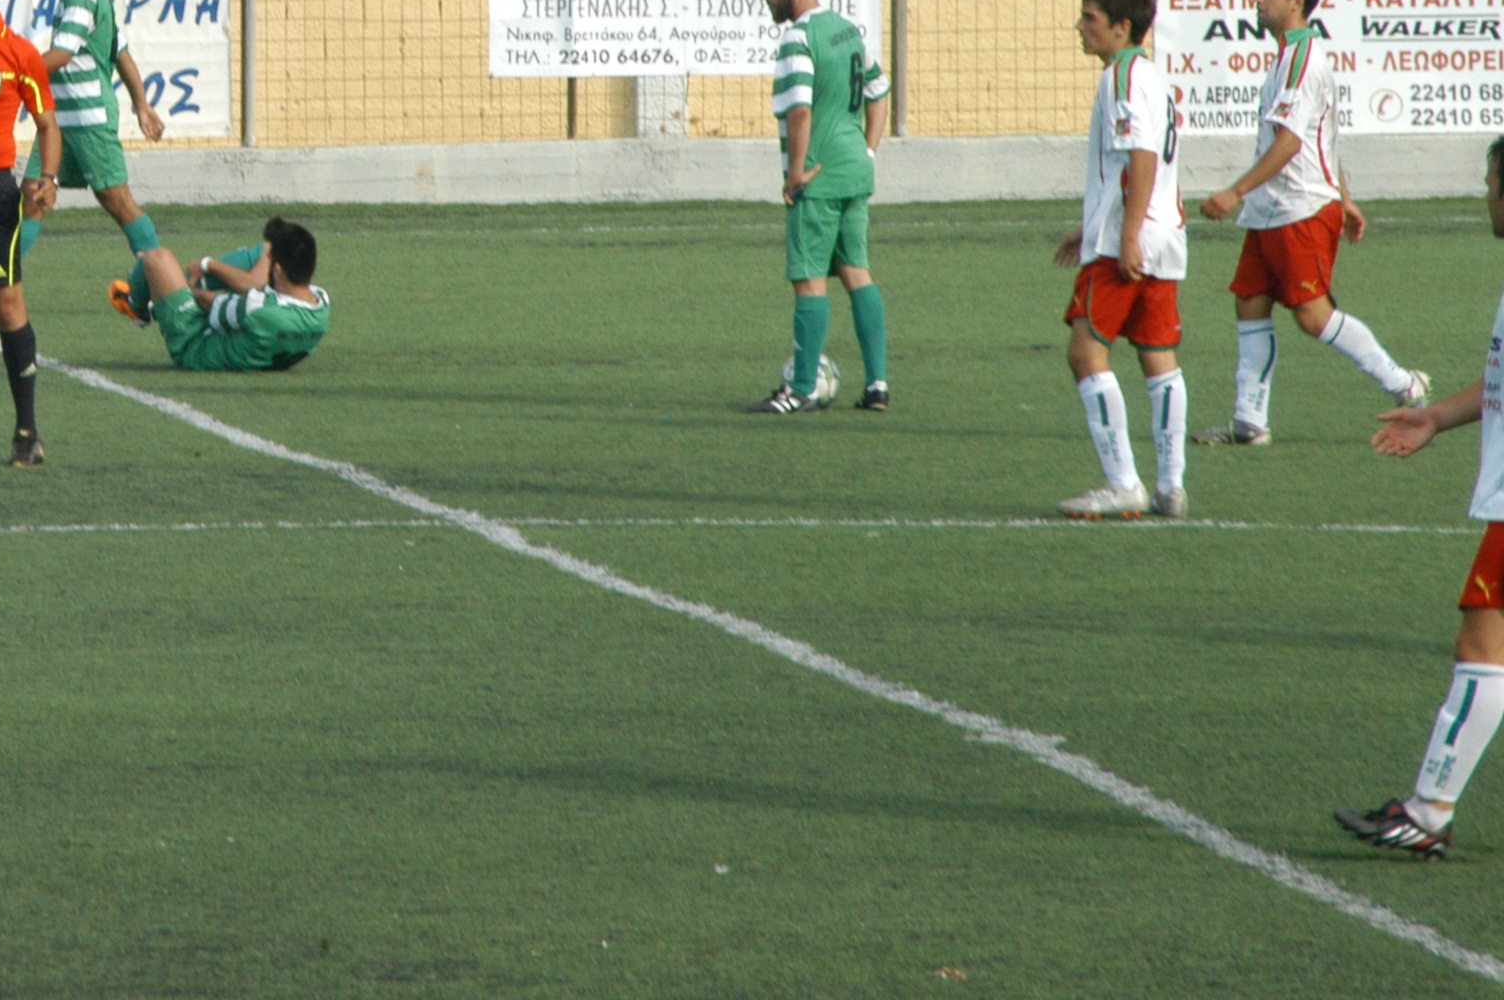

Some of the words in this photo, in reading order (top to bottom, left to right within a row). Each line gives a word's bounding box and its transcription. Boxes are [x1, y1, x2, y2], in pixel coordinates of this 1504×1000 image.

[1361, 14, 1502, 41] WALKER
[559, 49, 610, 66] 22410
[849, 52, 864, 114] 6
[1410, 84, 1472, 102] 22410
[1189, 109, 1259, 129] ΚΟΛΟΚΟΤΡ
[1411, 108, 1473, 127] 22410
